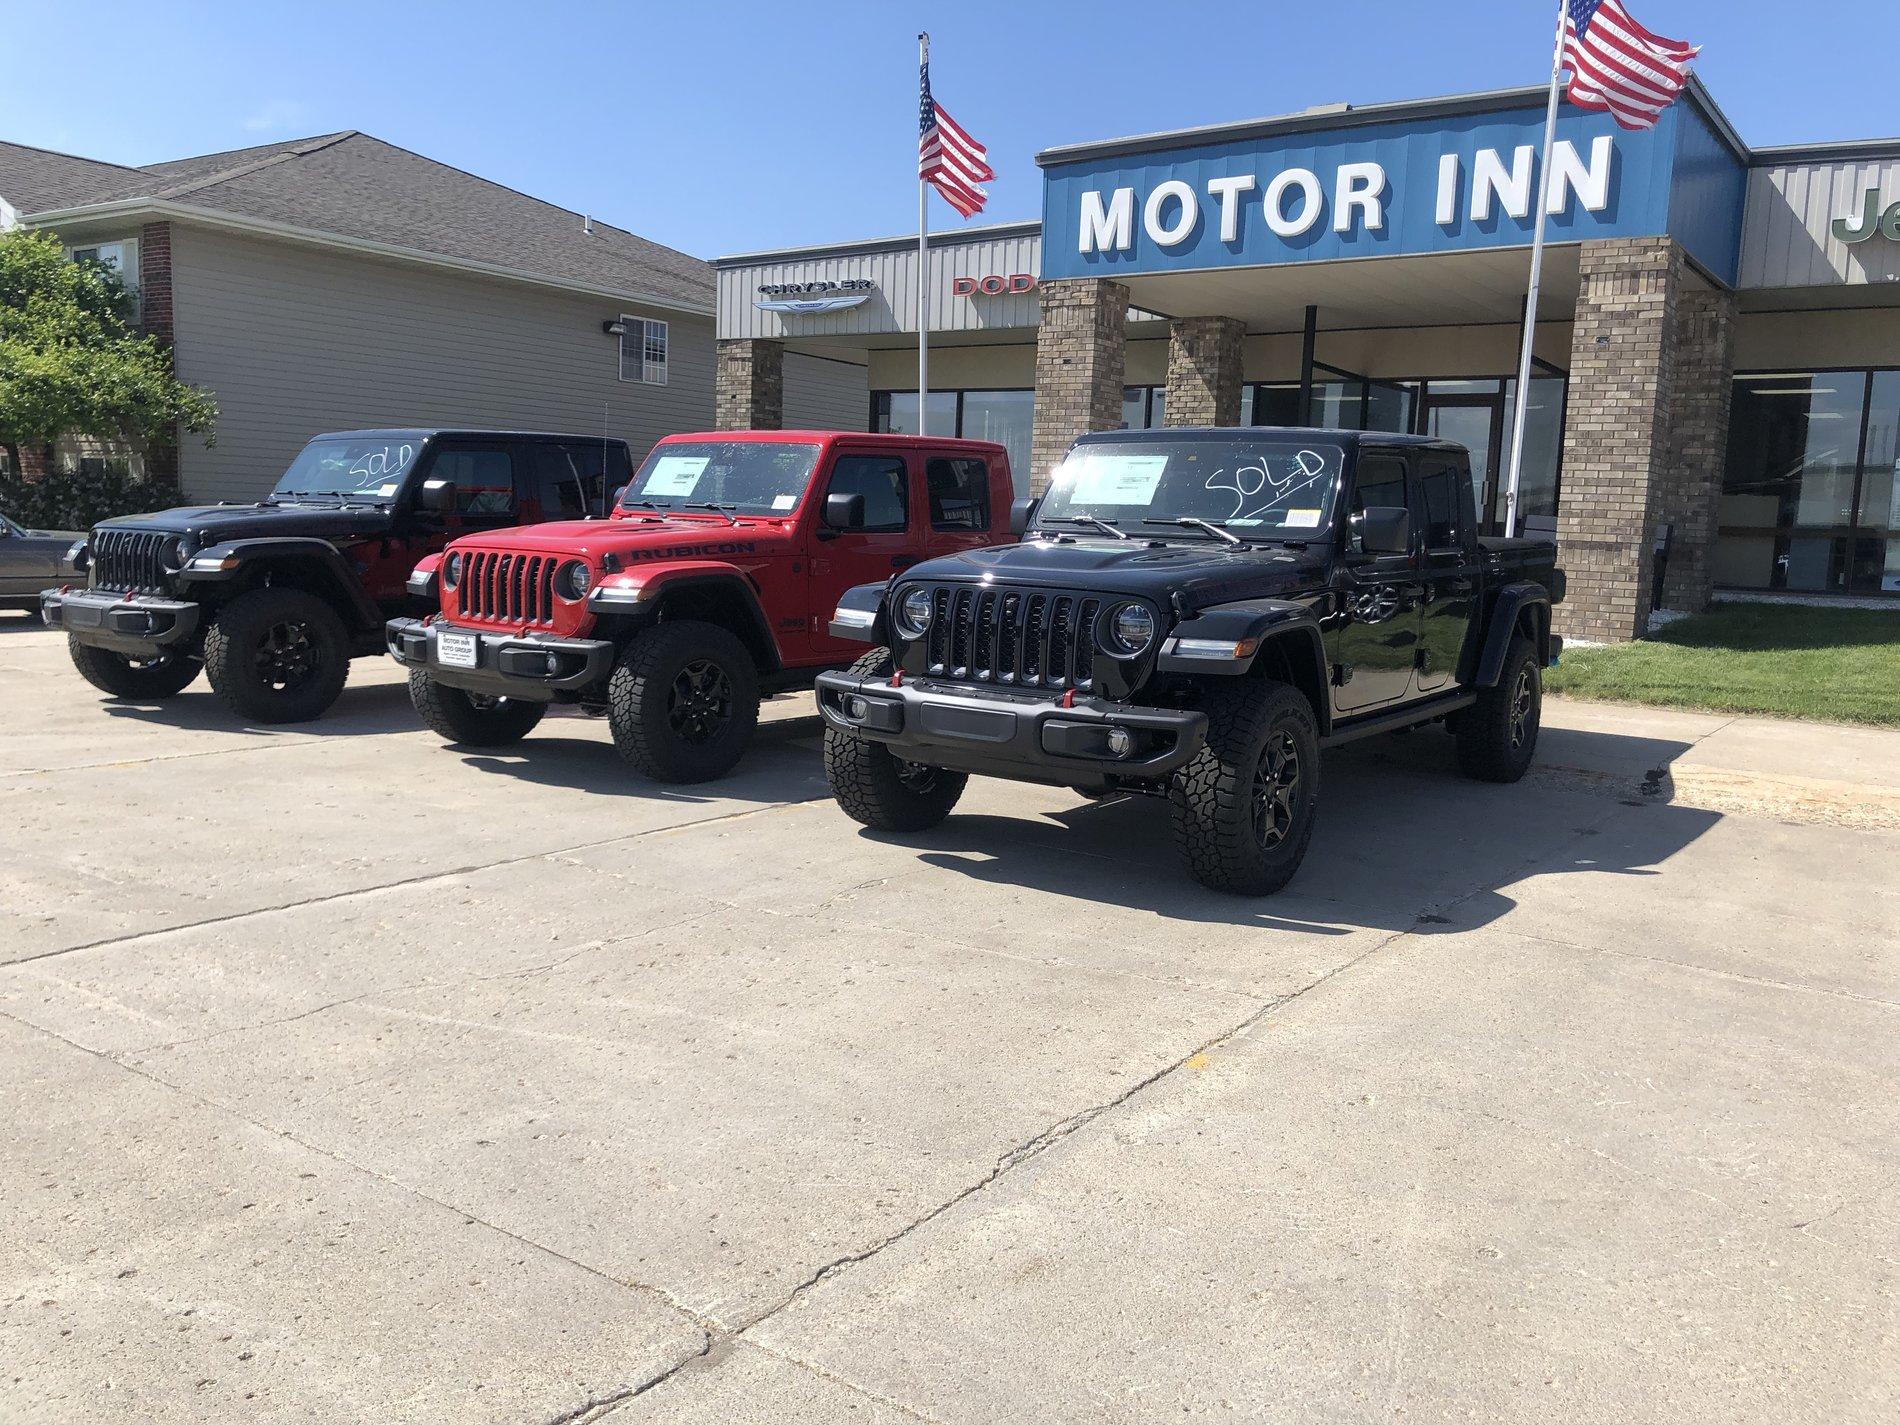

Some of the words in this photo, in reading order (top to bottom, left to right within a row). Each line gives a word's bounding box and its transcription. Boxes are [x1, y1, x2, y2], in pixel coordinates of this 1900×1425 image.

[1079, 162, 1386, 254] MOTOR
[1435, 136, 1613, 225] INN
[757, 278, 876, 295] CHRYSLER
[349, 444, 413, 487] SOLD
[1205, 450, 1325, 518] SOLD
[631, 542, 756, 560] RUBICON
